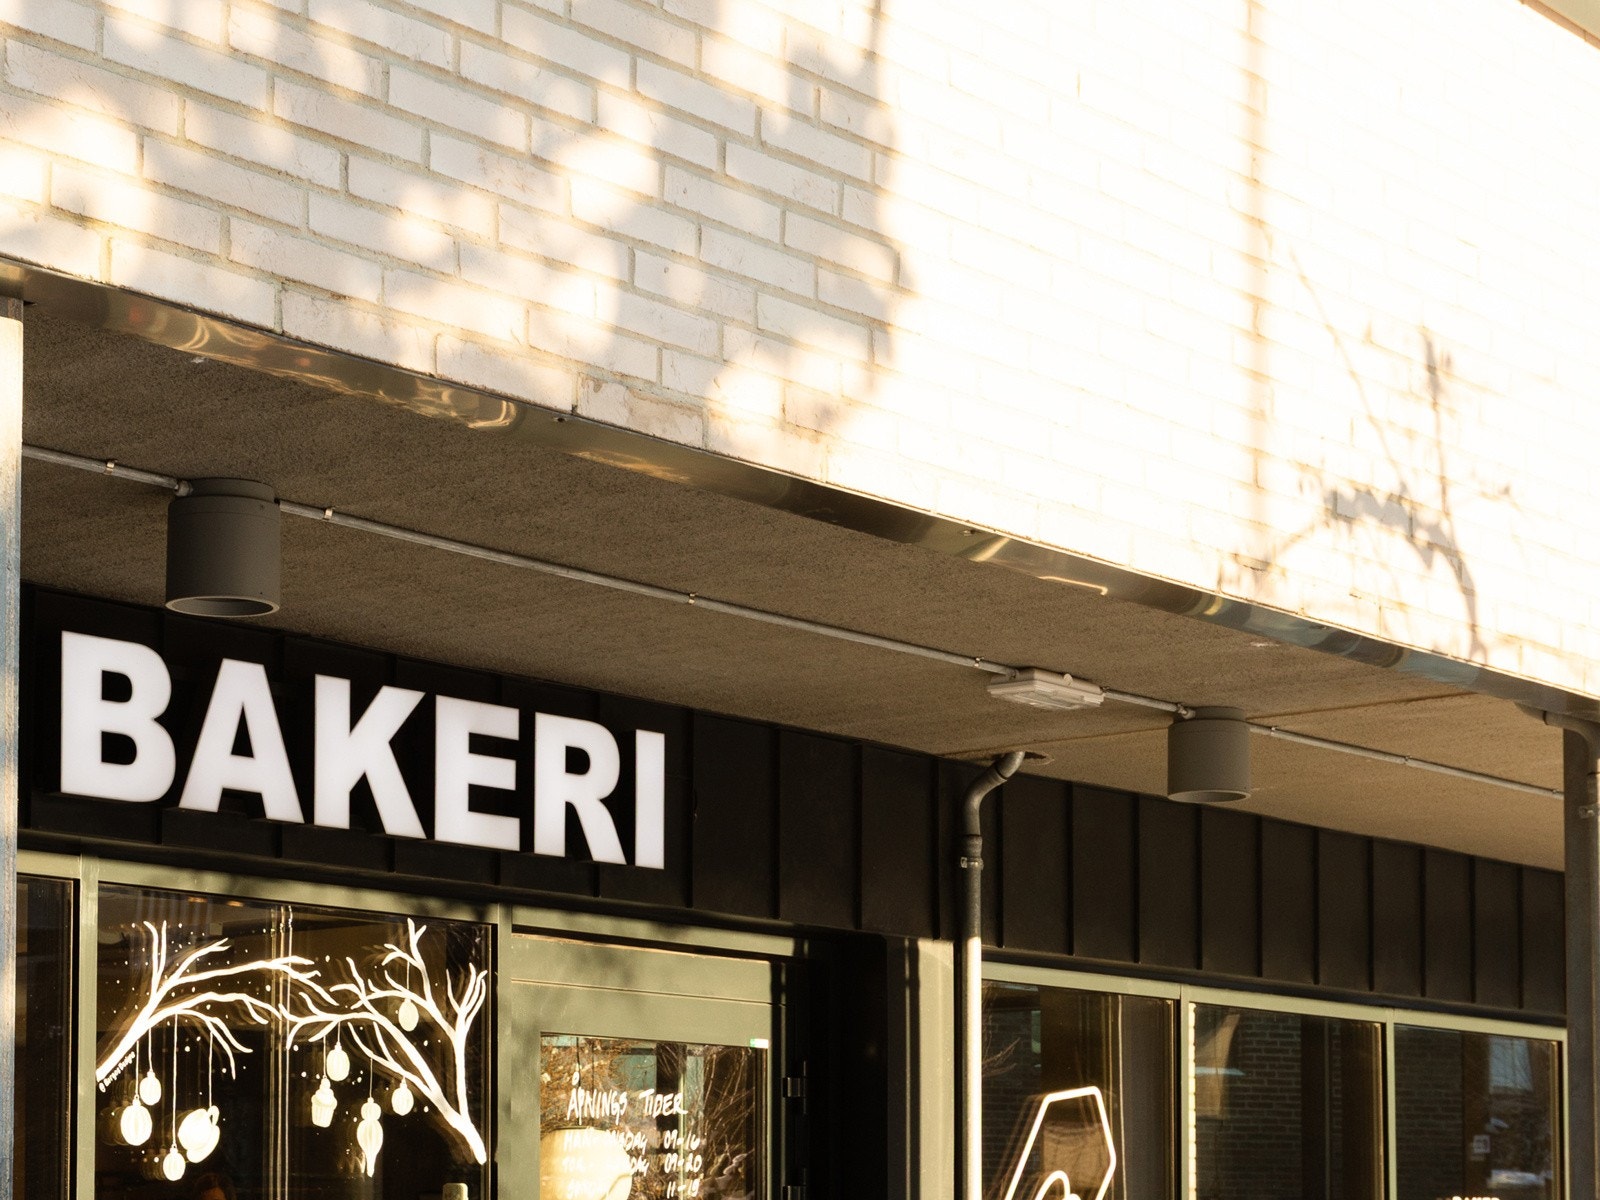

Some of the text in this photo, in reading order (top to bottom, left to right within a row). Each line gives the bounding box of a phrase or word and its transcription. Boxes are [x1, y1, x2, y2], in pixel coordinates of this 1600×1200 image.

[60, 631, 665, 869] BAKERI
[567, 1072, 688, 1125] ÅPNINGS TIDER
[664, 1153, 702, 1174] 09-20
